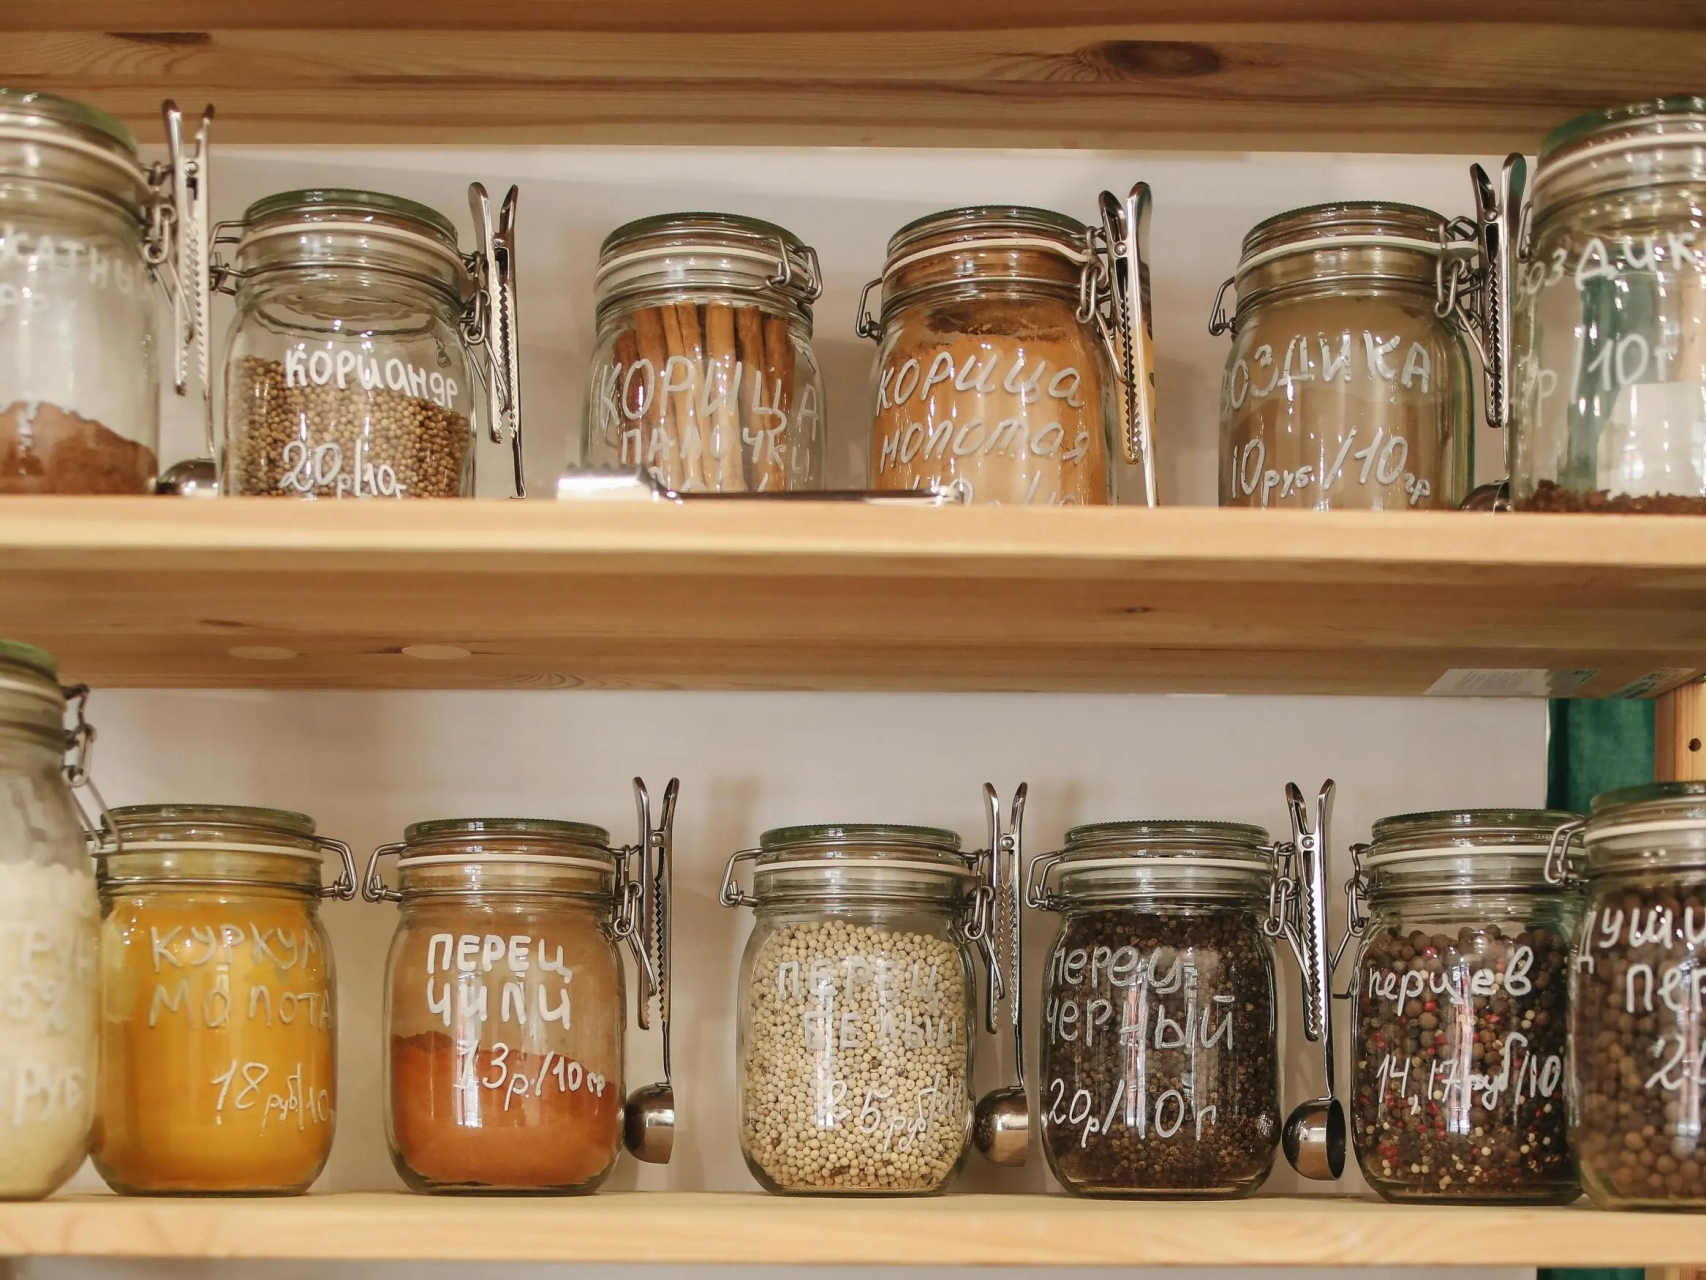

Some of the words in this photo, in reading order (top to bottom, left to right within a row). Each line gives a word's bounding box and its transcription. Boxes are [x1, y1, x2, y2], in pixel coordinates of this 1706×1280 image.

[597, 355, 819, 441] КОРИЦА
[150, 922, 331, 979] КУРКУМ
[427, 933, 573, 984] ПЕРЕЦ
[427, 976, 571, 1030] ЧИЛИ
[778, 957, 939, 1013] ПЕРЕЦ
